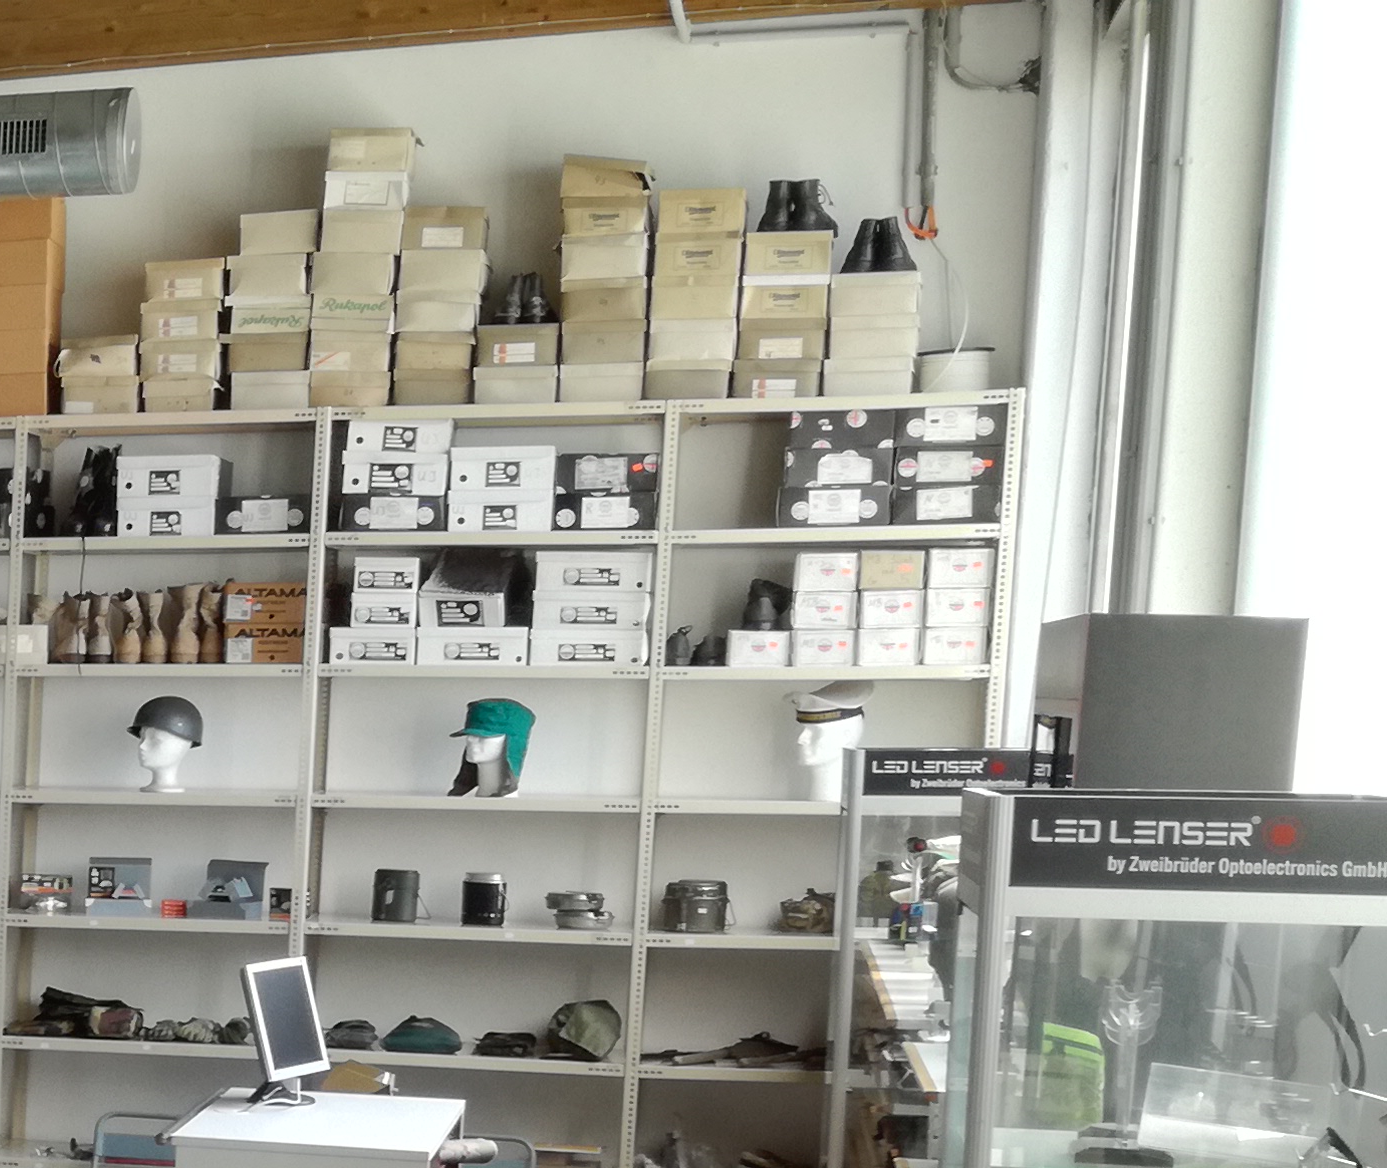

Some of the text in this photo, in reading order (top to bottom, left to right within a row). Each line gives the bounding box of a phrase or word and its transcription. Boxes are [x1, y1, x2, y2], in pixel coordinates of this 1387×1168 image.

[872, 760, 984, 774] LED LENSER
[1031, 818, 1254, 847] LED LENSER
[1107, 856, 1387, 879] by Zweibrüder Optoelectronics GmbH
